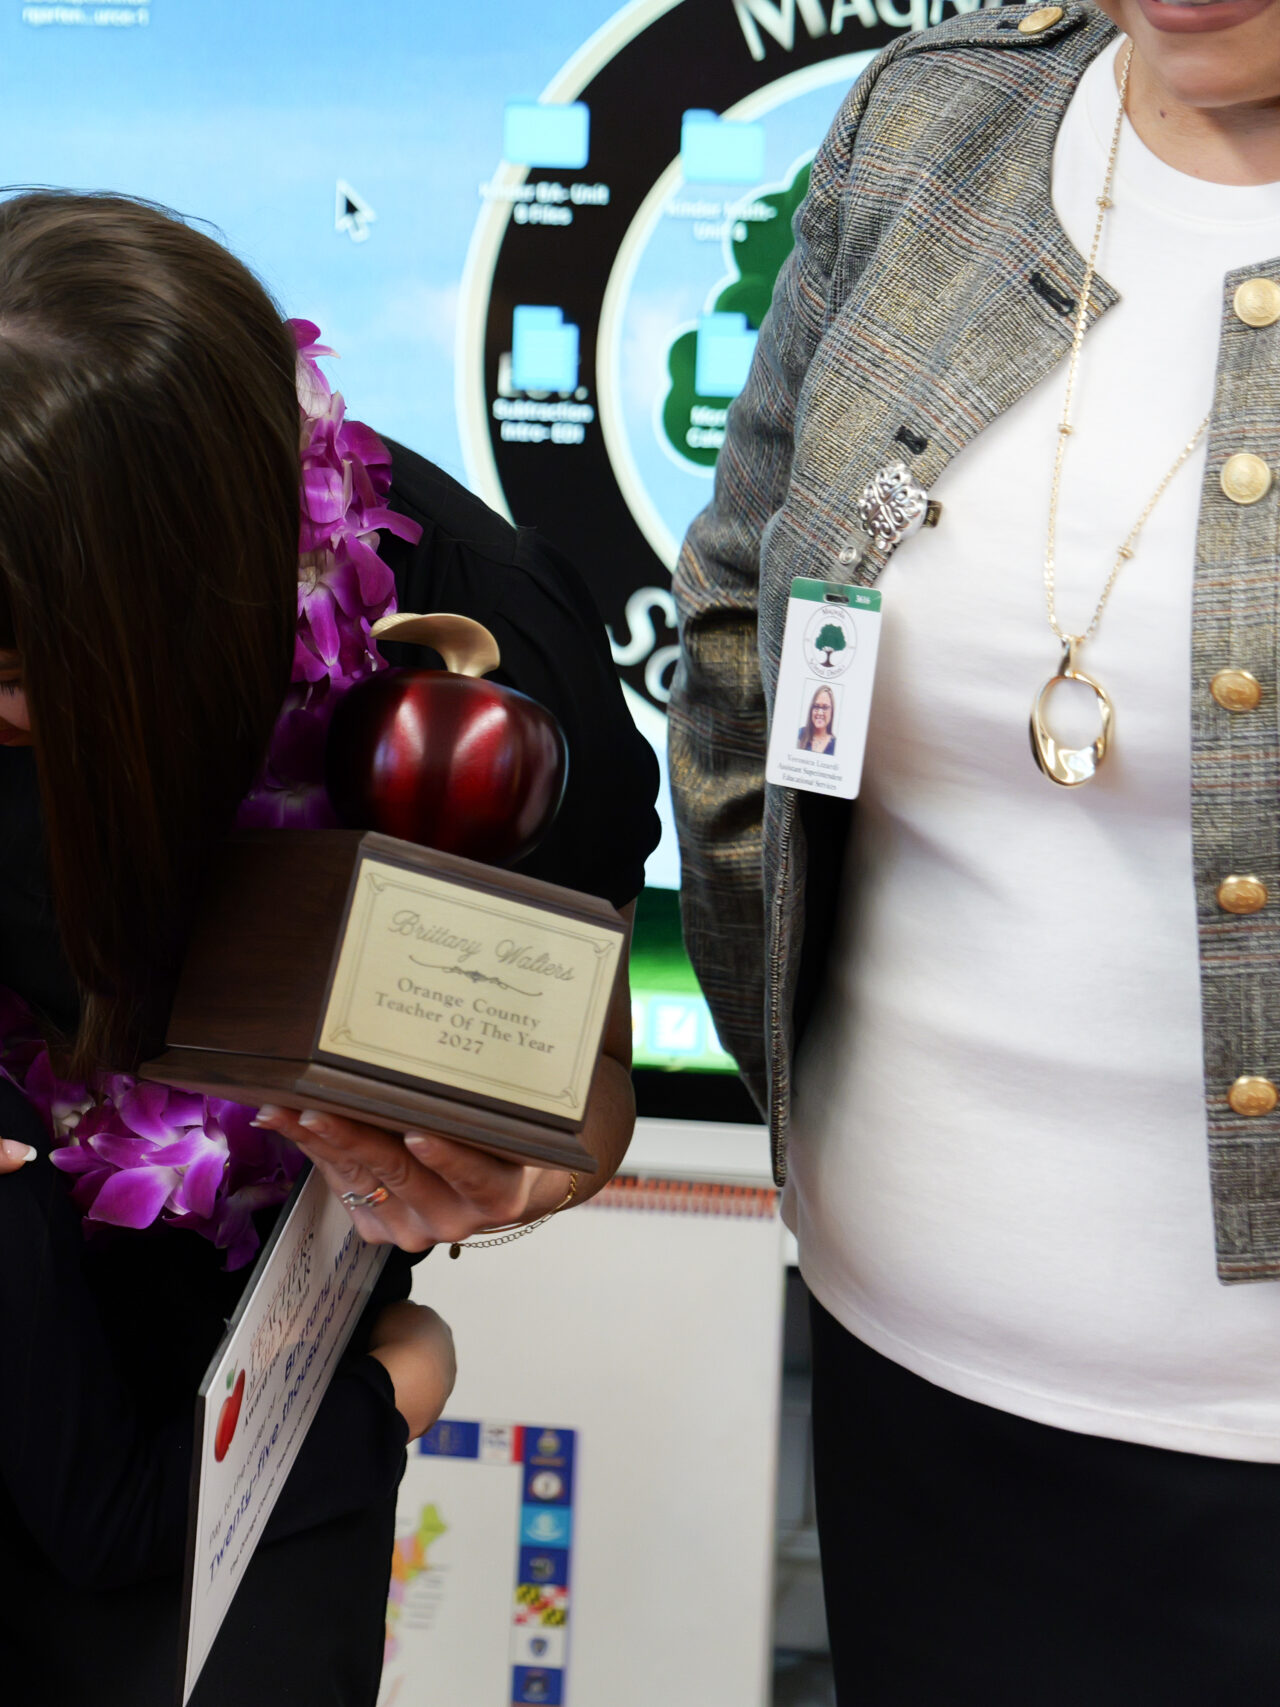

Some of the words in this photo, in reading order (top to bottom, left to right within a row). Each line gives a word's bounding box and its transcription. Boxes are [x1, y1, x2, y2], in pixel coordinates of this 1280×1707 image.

[388, 909, 481, 963] Brittany
[374, 991, 443, 1024] Teacher
[450, 1013, 474, 1031] Of
[480, 1020, 512, 1043] The
[518, 1031, 556, 1054] Year
[397, 977, 464, 1008] Orange
[472, 998, 541, 1030] County
[437, 1031, 485, 1055] 2027
[284, 1272, 332, 1383] Brittany
[283, 1294, 336, 1422] thousand
